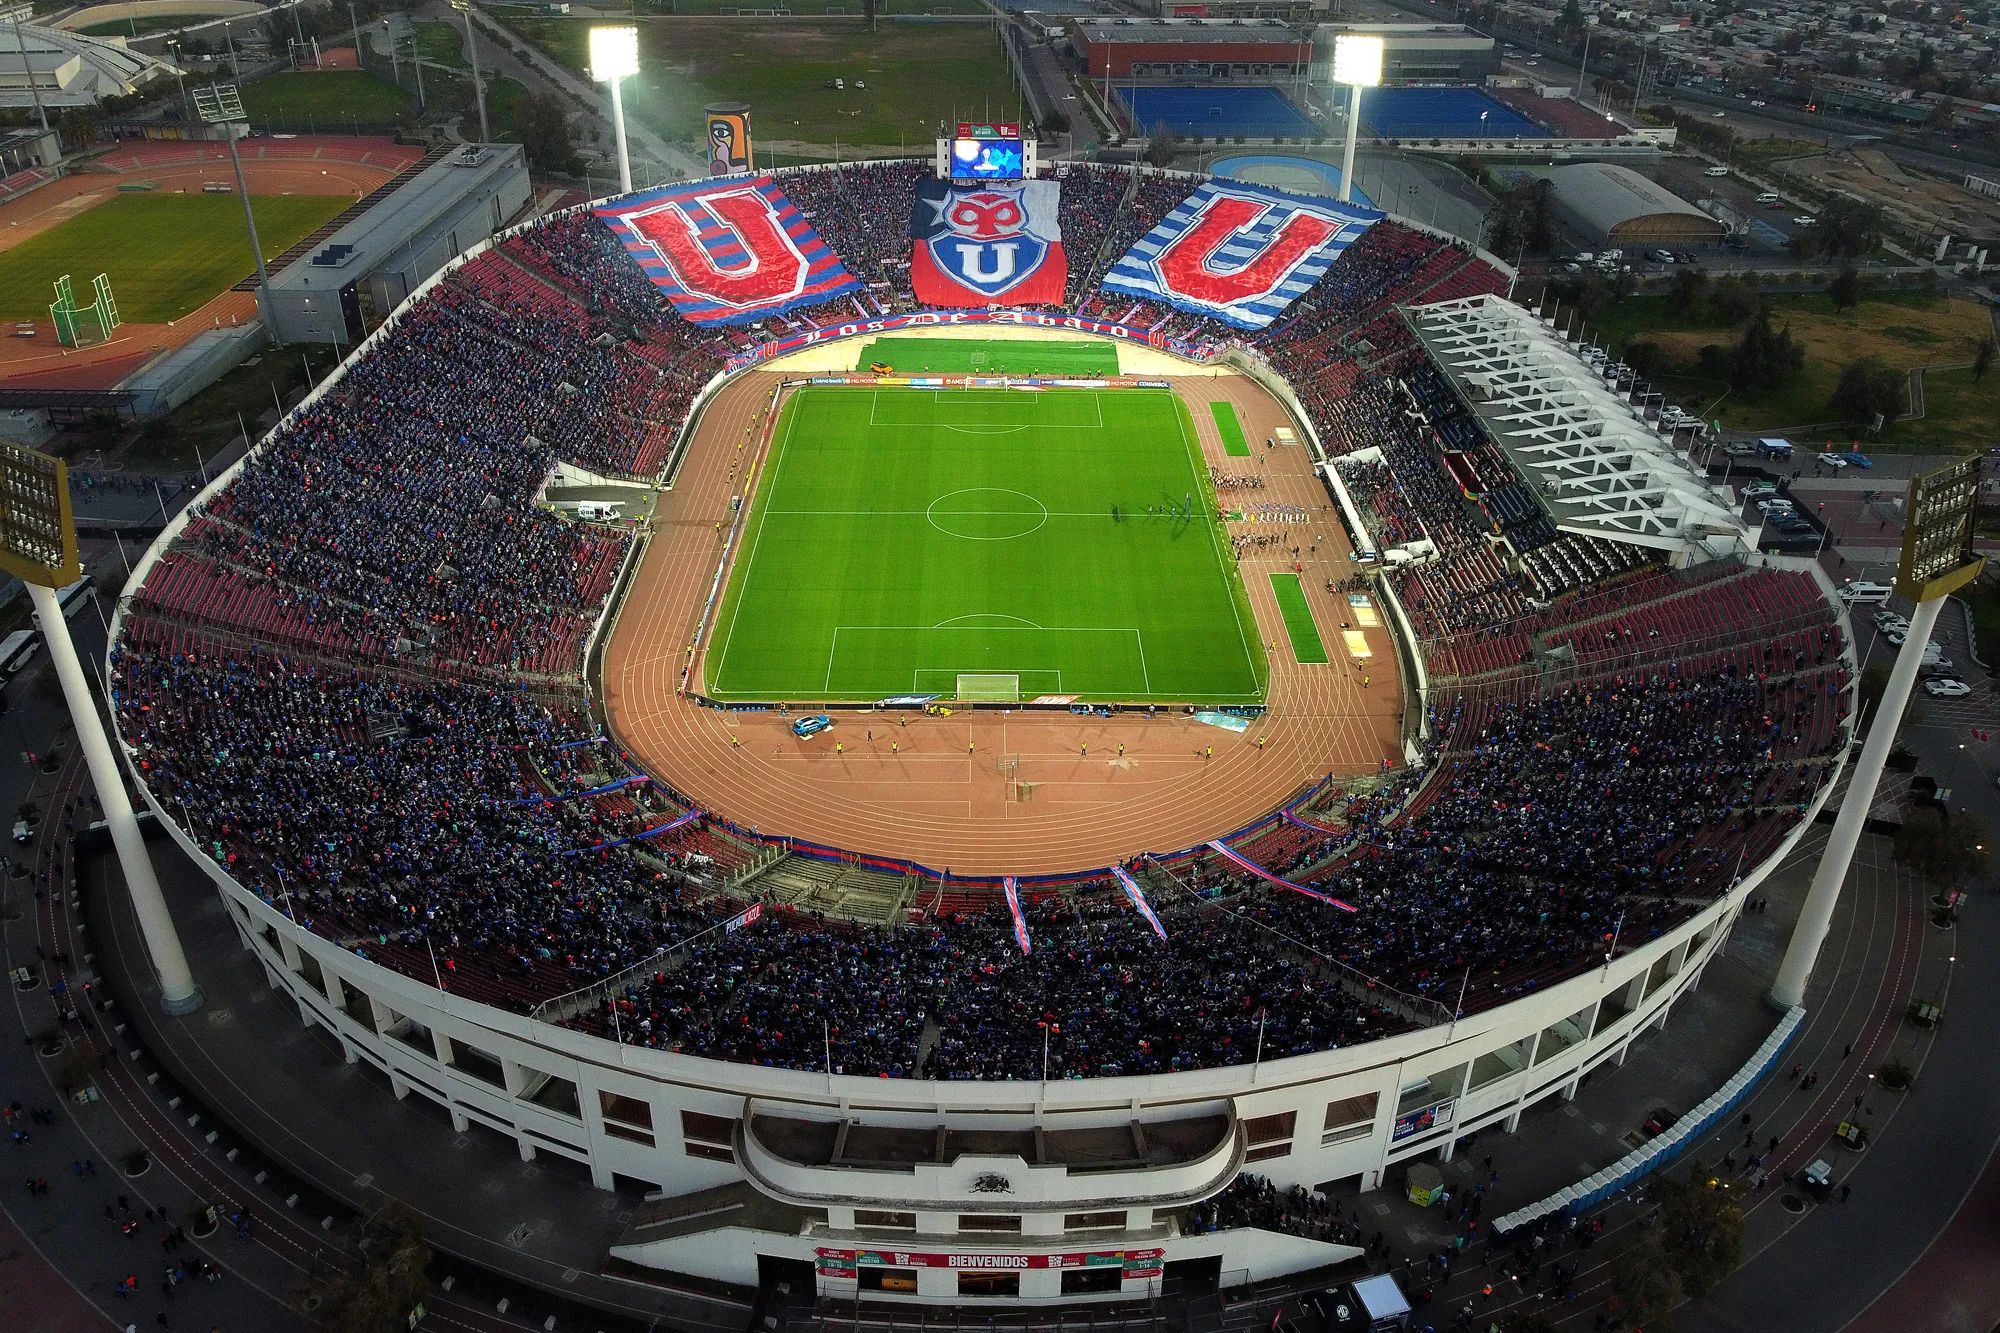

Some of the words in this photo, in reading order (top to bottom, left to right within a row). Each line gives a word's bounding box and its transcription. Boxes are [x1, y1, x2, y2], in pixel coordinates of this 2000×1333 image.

[618, 187, 810, 309] U
[955, 243, 1020, 283] U
[1147, 191, 1352, 311] U
[763, 340, 778, 359] U
[948, 1255, 1028, 1267] BIENVENIDOS
